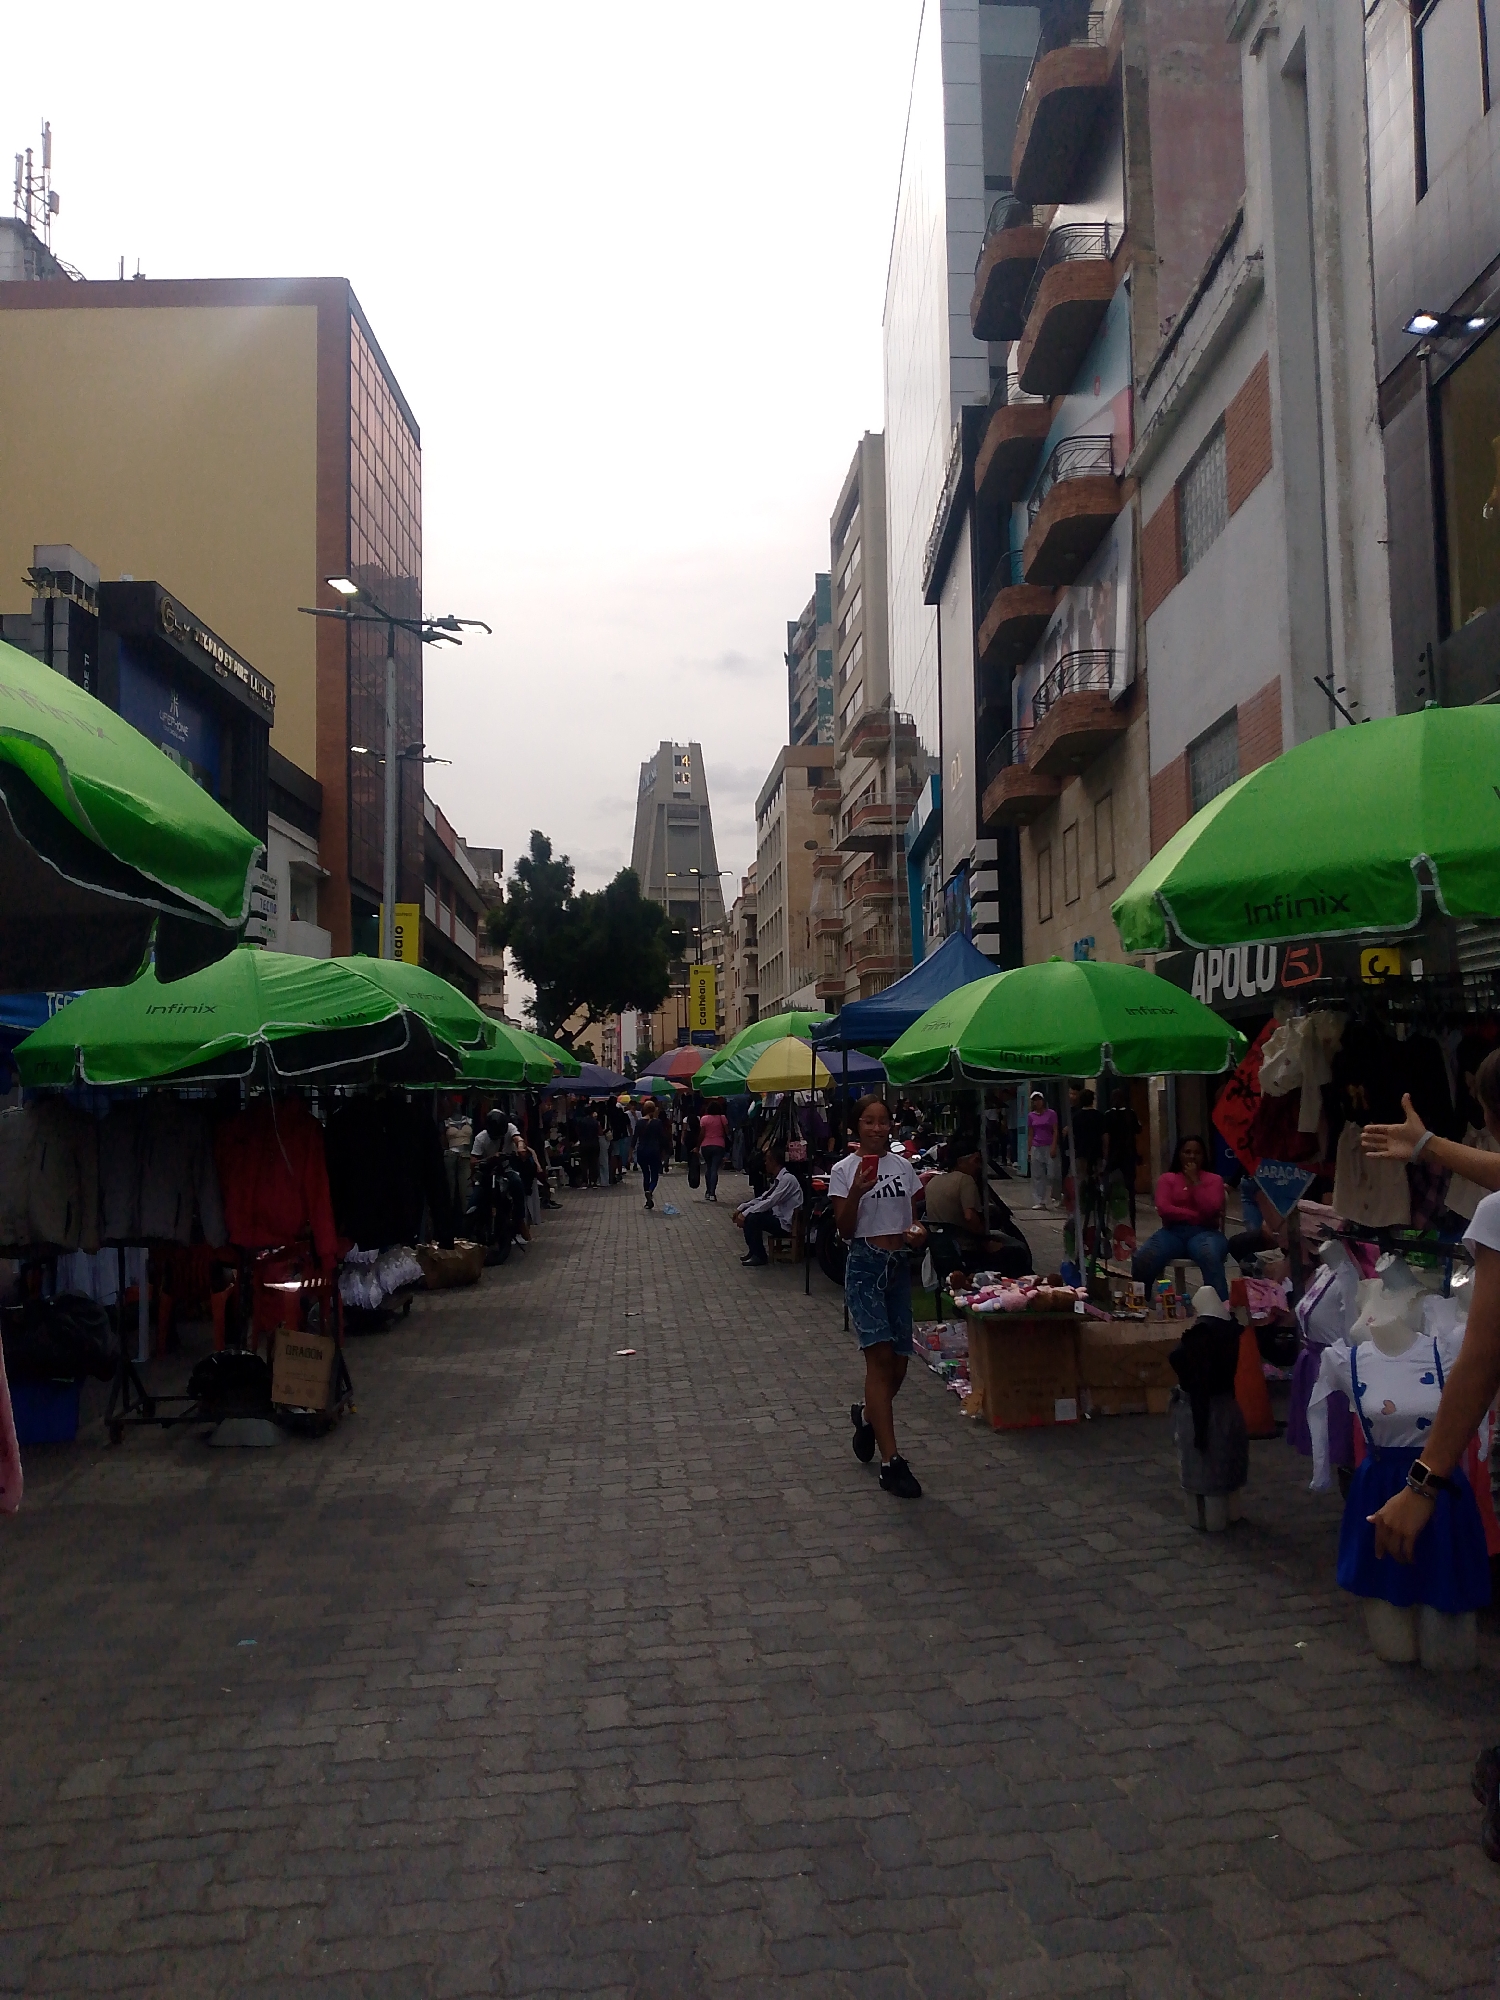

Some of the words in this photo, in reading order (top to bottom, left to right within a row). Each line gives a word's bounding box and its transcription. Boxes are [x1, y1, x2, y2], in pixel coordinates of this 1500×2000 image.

[1244, 889, 1350, 926] Infinix
[146, 1003, 217, 1015] Infinix
[1125, 1006, 1179, 1017] Infinix
